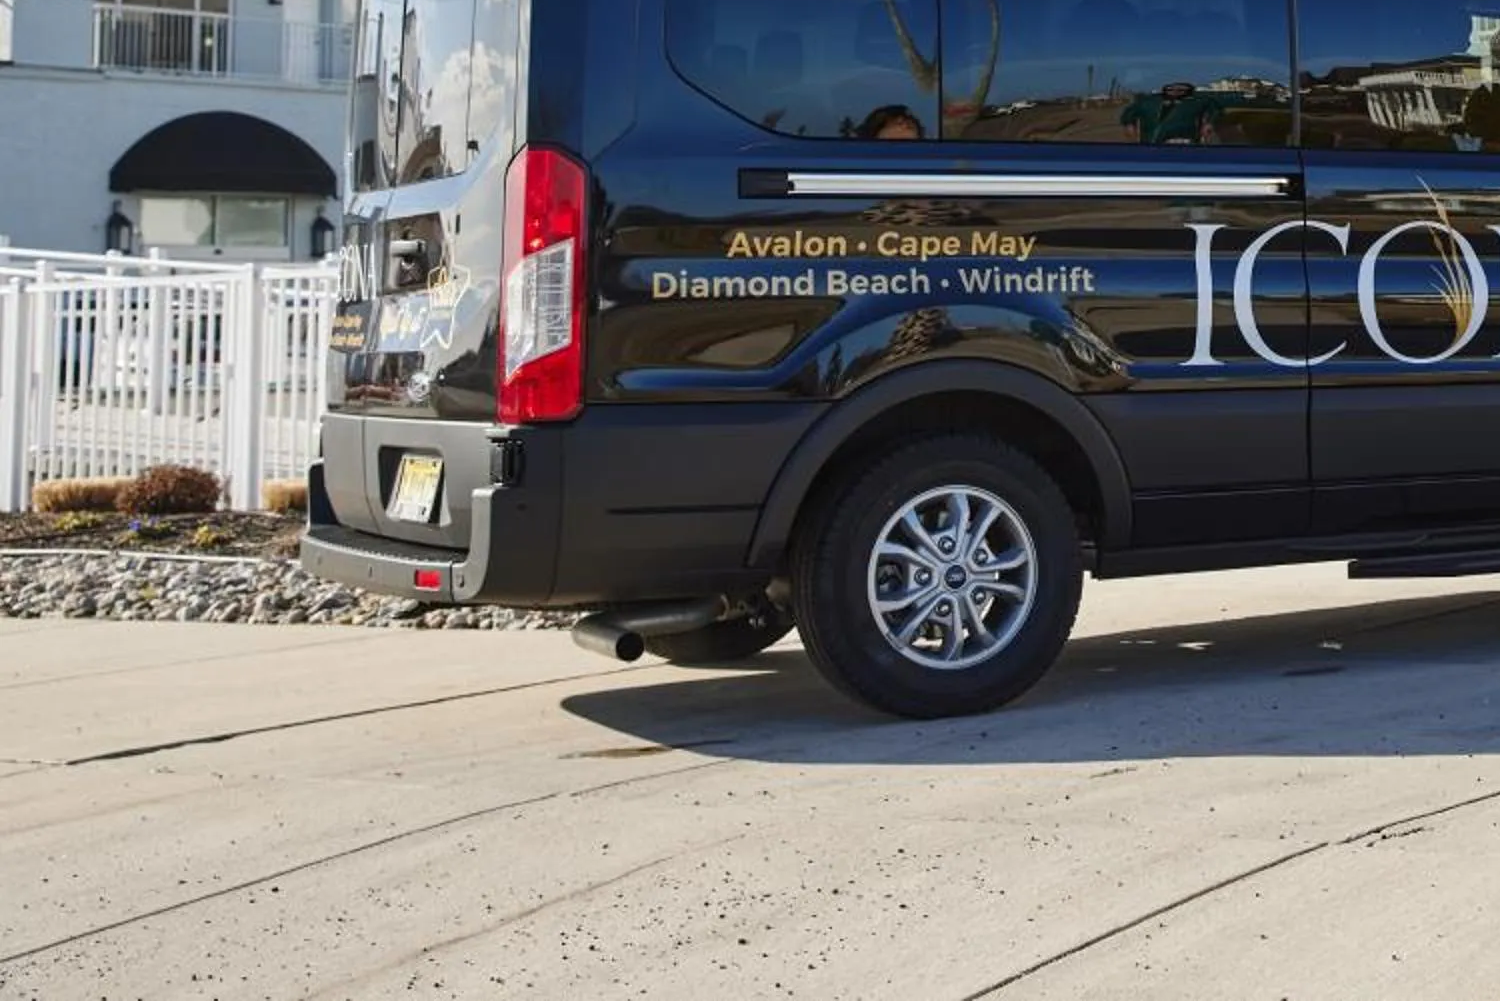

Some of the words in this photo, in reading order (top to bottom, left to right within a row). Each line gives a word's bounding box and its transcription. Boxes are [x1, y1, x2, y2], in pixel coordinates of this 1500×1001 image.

[726, 230, 847, 258] Avalon
[877, 230, 961, 262] Cape
[971, 230, 1037, 261] May
[652, 268, 815, 299] Diamond
[827, 267, 931, 297] Beach
[957, 266, 1095, 294] Windrift
